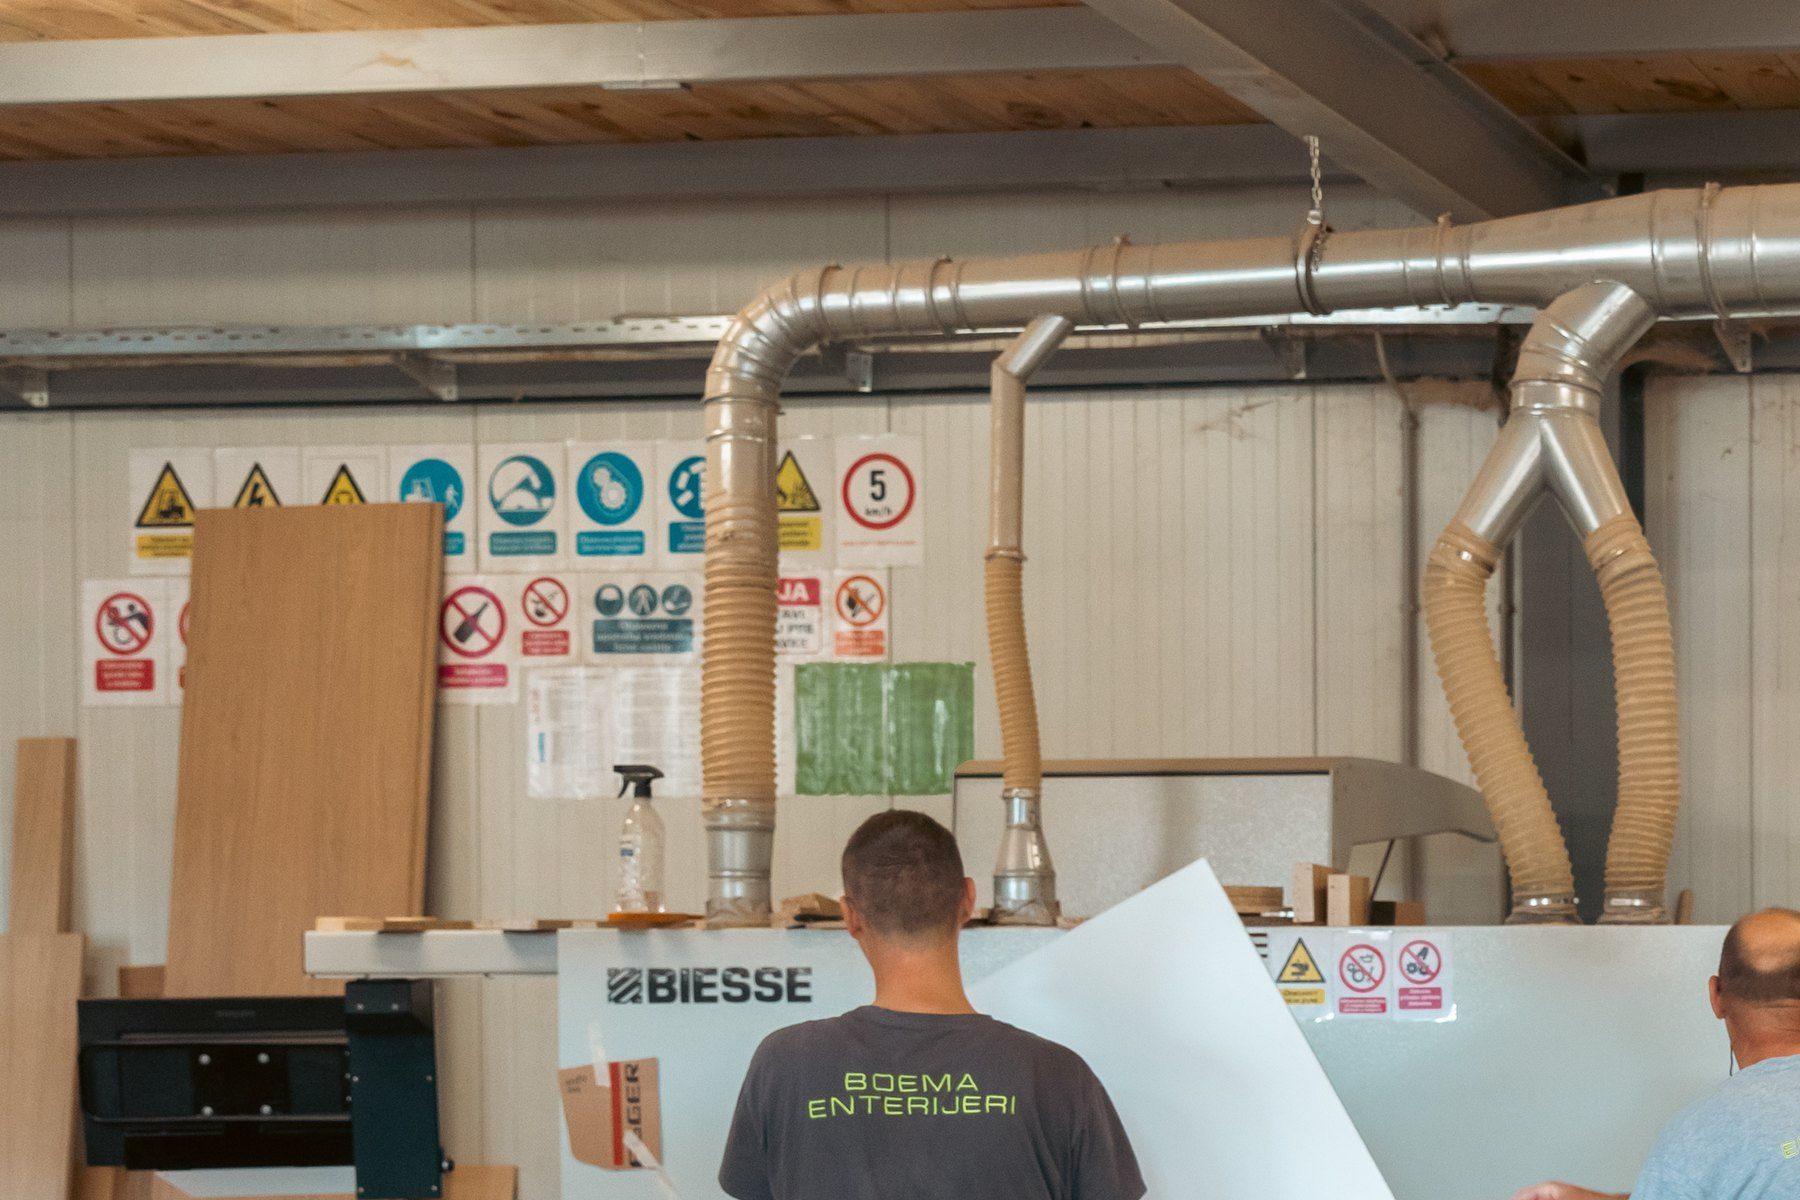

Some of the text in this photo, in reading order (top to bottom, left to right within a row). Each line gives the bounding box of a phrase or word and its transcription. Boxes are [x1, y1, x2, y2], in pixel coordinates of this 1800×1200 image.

[870, 469, 886, 501] 5
[647, 967, 813, 1004] BIESSE
[844, 1072, 979, 1092] BOEMA
[808, 1095, 1016, 1118] ENTERIJERI
